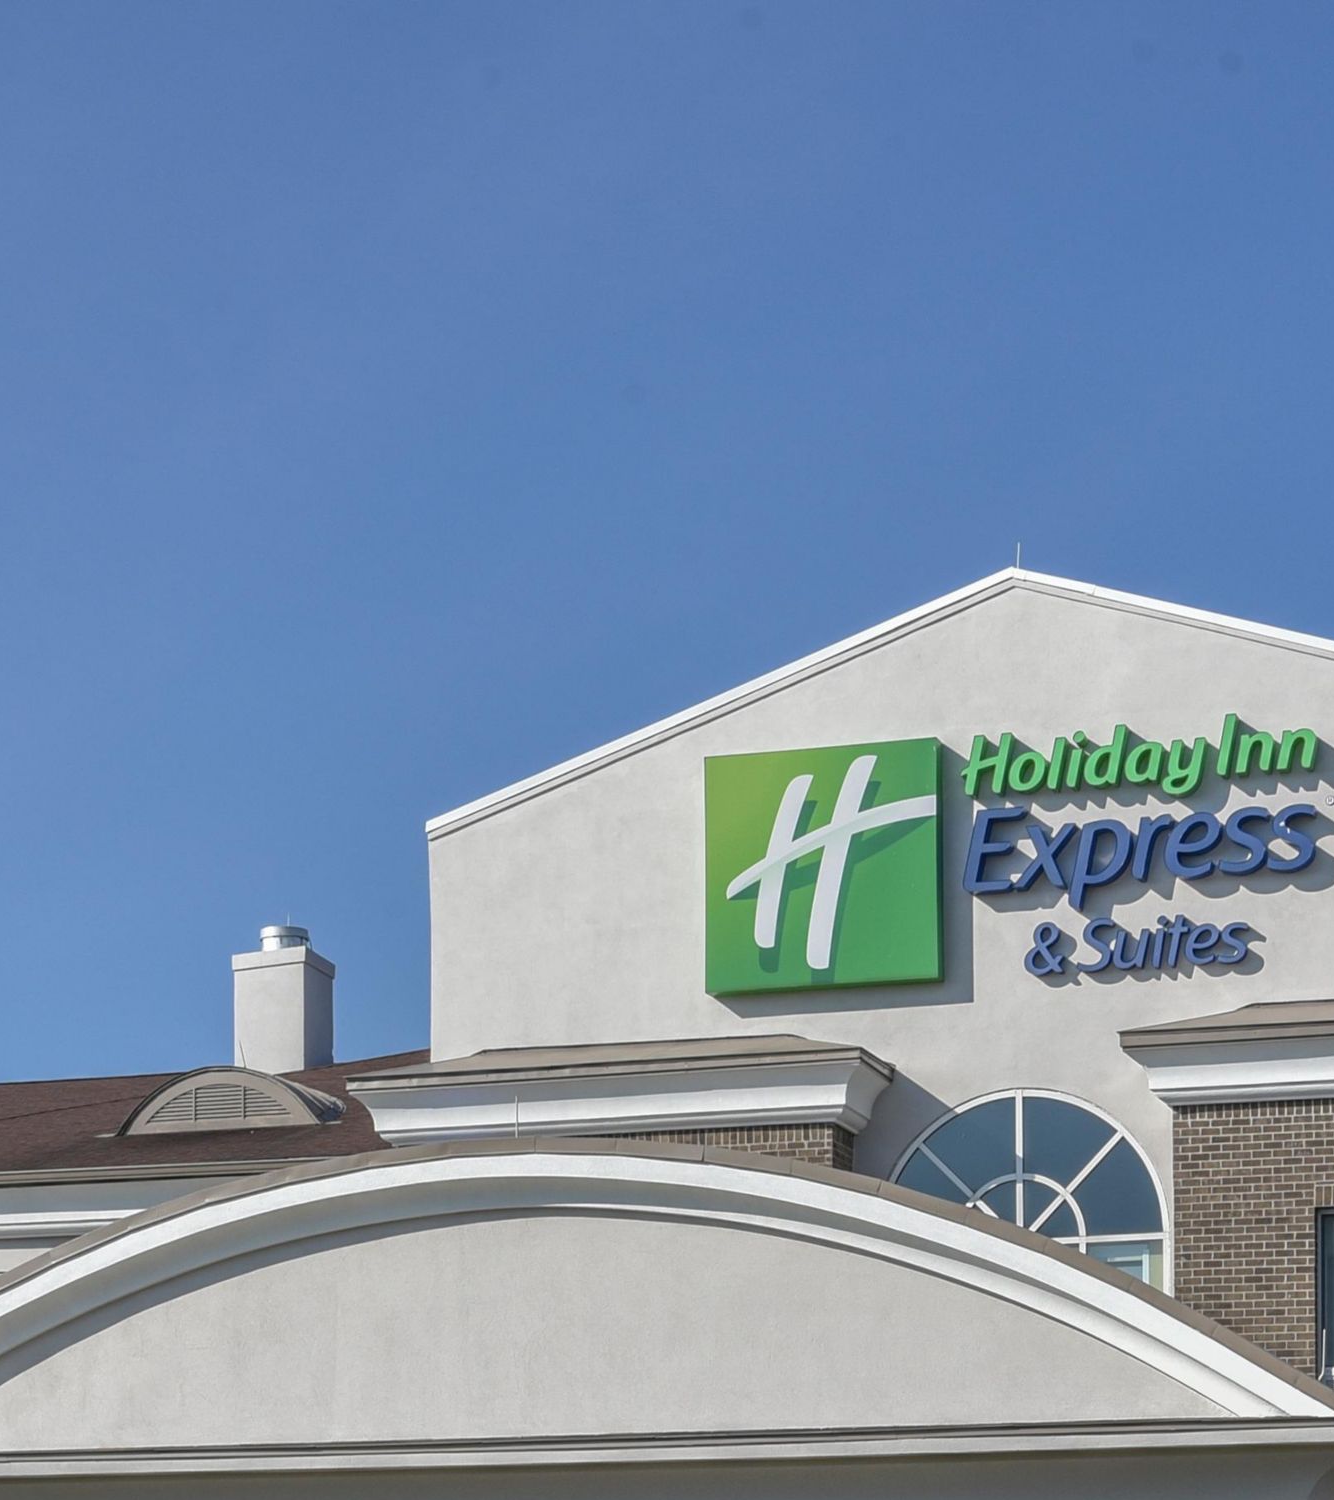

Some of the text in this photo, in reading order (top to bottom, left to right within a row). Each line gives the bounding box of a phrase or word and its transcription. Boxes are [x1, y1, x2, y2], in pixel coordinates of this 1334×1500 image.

[961, 713, 1318, 797] Holiday Inn
[962, 804, 1317, 911] Express
[1024, 914, 1249, 975] & Suites
